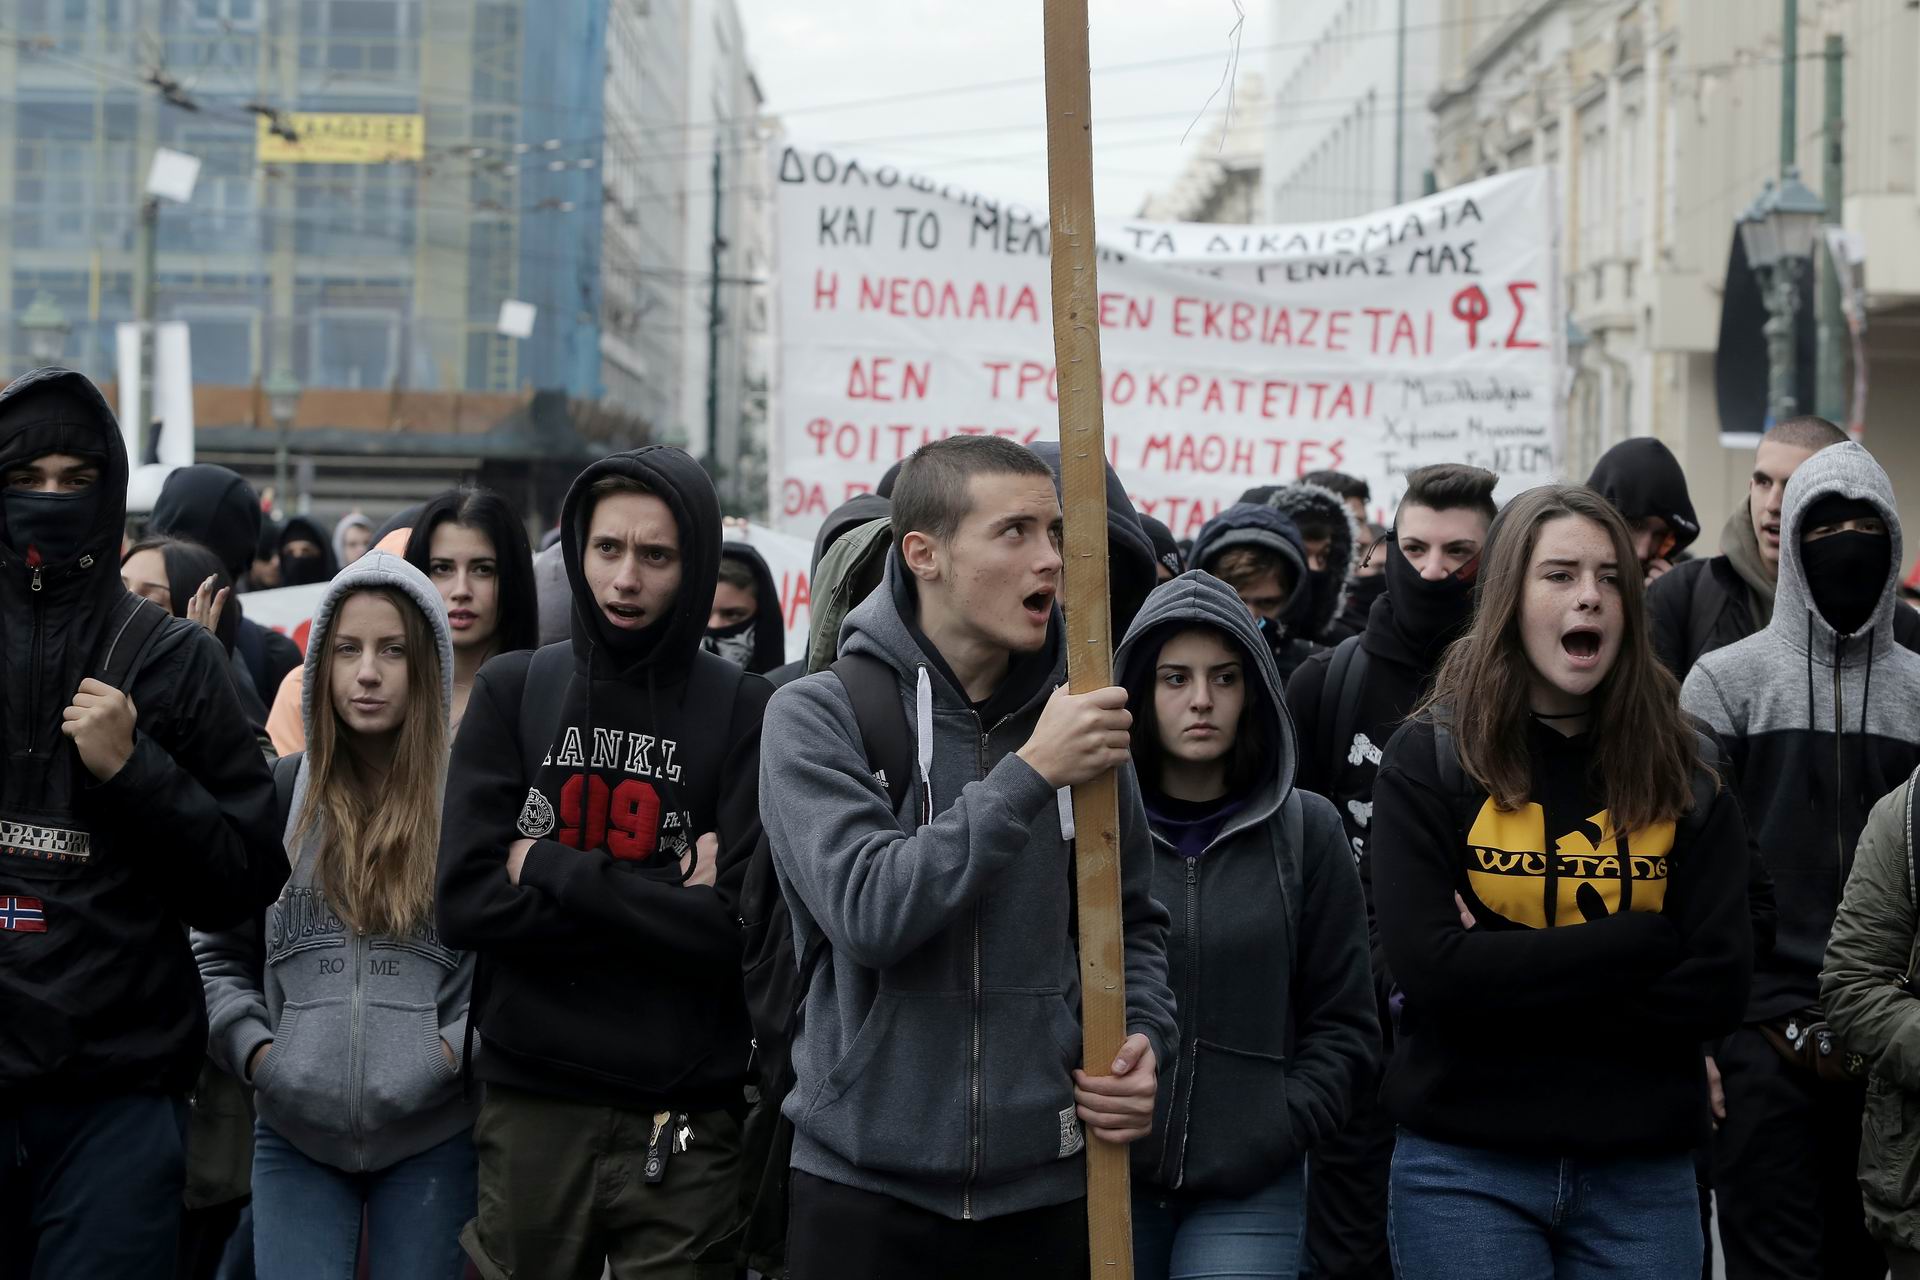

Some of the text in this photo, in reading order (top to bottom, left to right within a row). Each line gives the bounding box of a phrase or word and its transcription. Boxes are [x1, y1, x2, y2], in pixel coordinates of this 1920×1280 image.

[818, 207, 876, 246] ΚΑΙ
[895, 208, 941, 250] ΤΟ
[1408, 241, 1481, 275] ΜΑΣ
[1124, 226, 1176, 253] ΤΑ
[814, 269, 838, 311] Η
[858, 276, 1040, 323] ΝΕΟΛΑΙΑ
[1098, 292, 1154, 328] ΕΝ
[1172, 297, 1435, 356] ΕΚΒΙΑΖΕΤΑΙ
[847, 356, 932, 400] ΔΕΝ
[982, 362, 1374, 420] ΤΡΟΟΚΡΑΤΕΙΤΑΙ
[1141, 433, 1346, 476] ΜΑΘΗΤΕΣ
[541, 726, 686, 786] ANKL
[0, 822, 89, 854] PAPIJRI
[1475, 848, 1668, 878] WU-TANG
